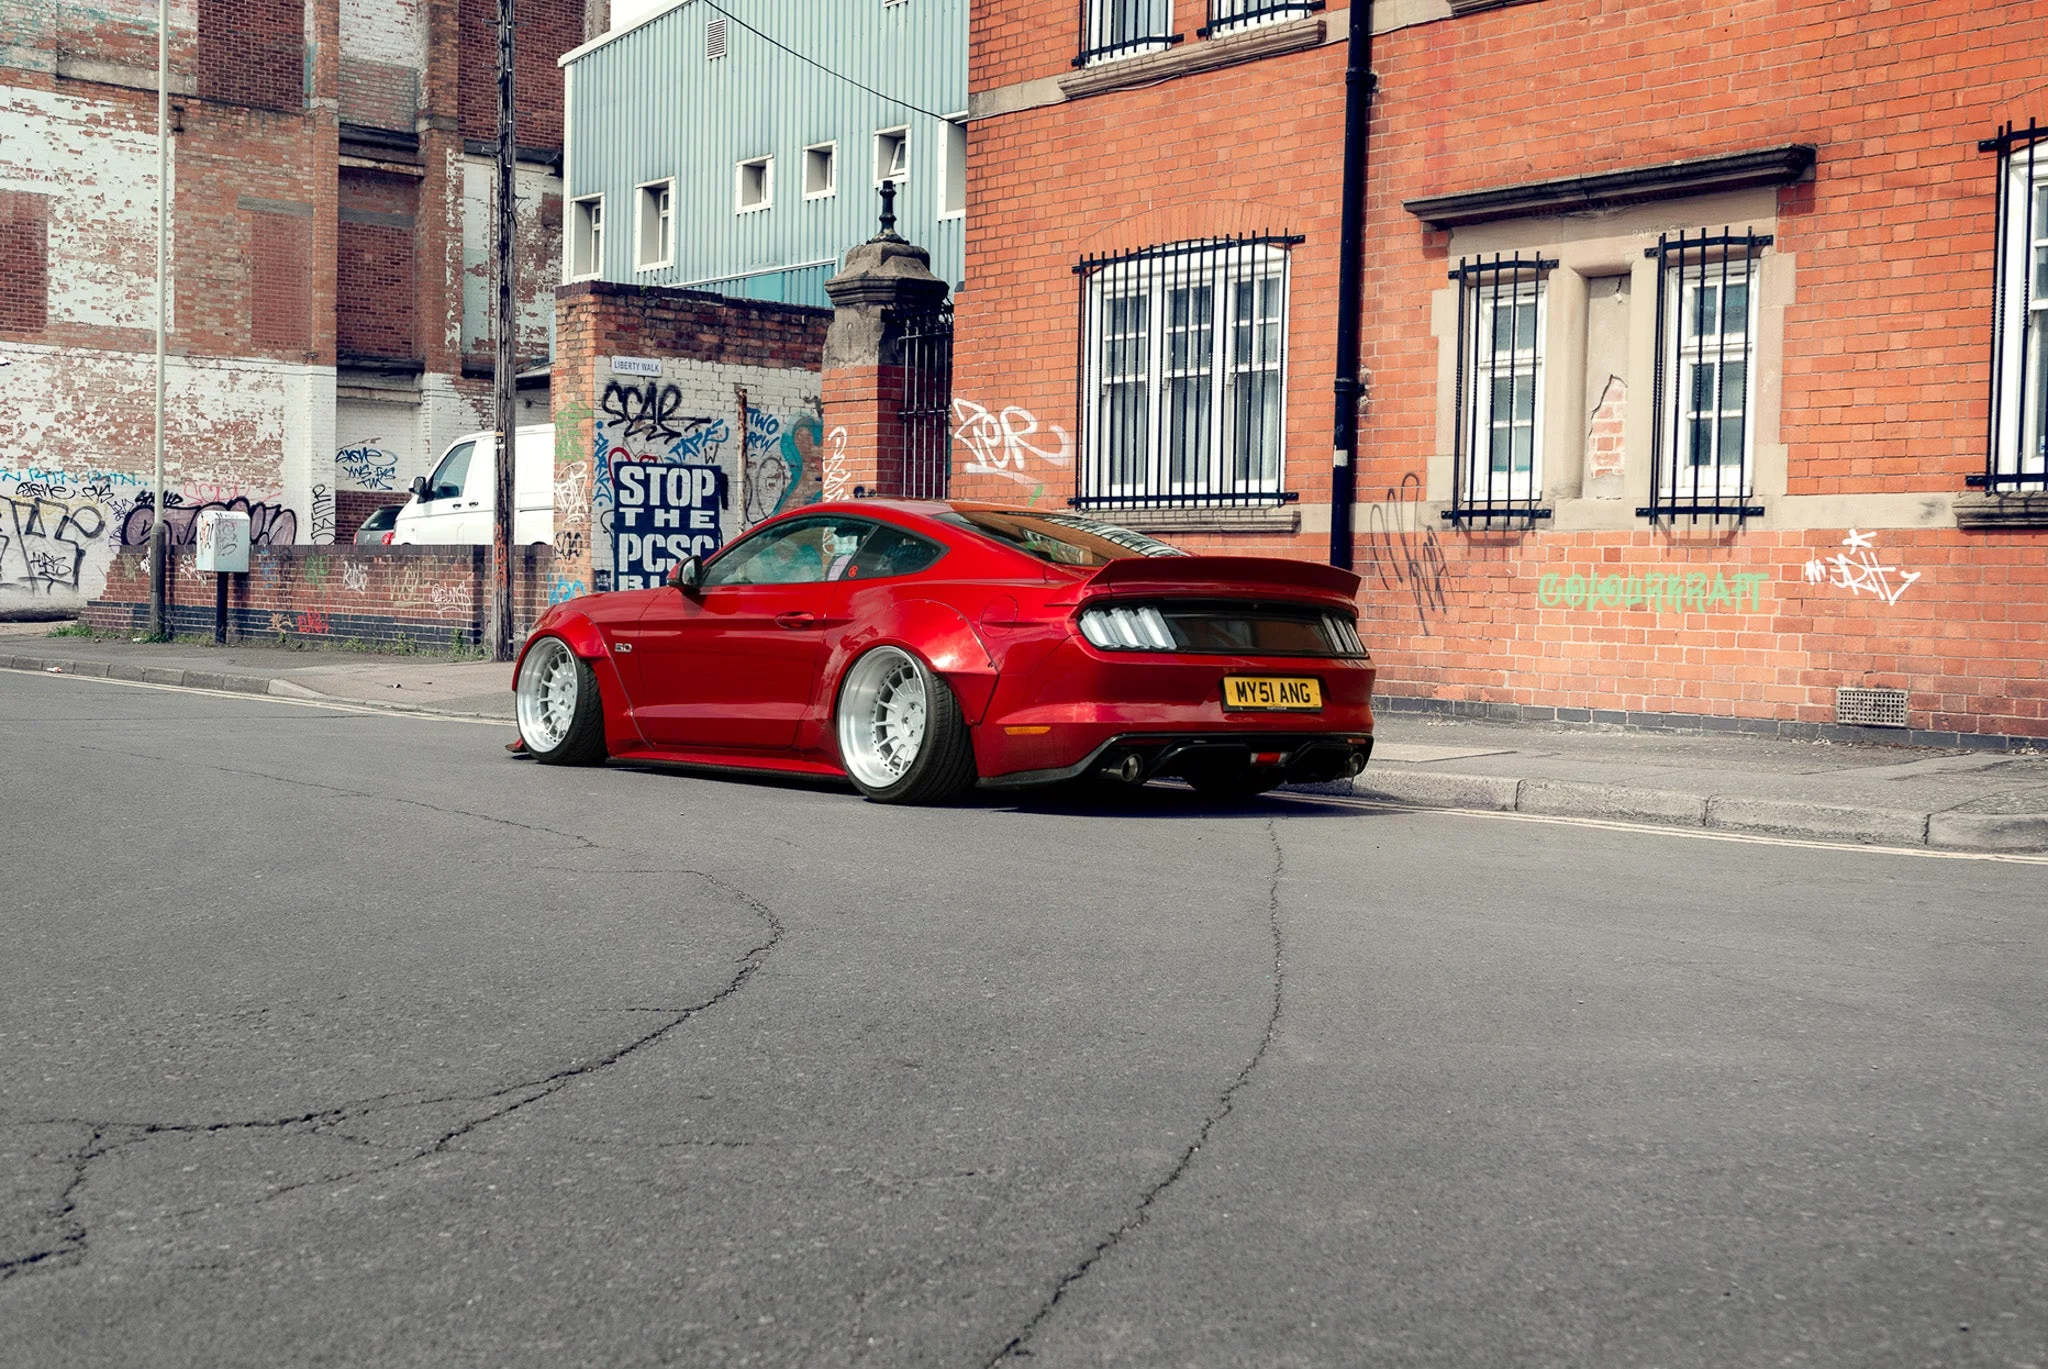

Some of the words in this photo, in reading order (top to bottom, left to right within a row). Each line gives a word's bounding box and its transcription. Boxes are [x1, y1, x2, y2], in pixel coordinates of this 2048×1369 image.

[614, 361, 641, 371] LIBERTY
[641, 363, 660, 373] WALK
[746, 407, 780, 436] TWO
[619, 465, 716, 508] STOP
[618, 507, 715, 529] THE
[618, 533, 715, 573] PCSC
[1235, 681, 1275, 703] MY51
[1279, 682, 1311, 704] ANG
